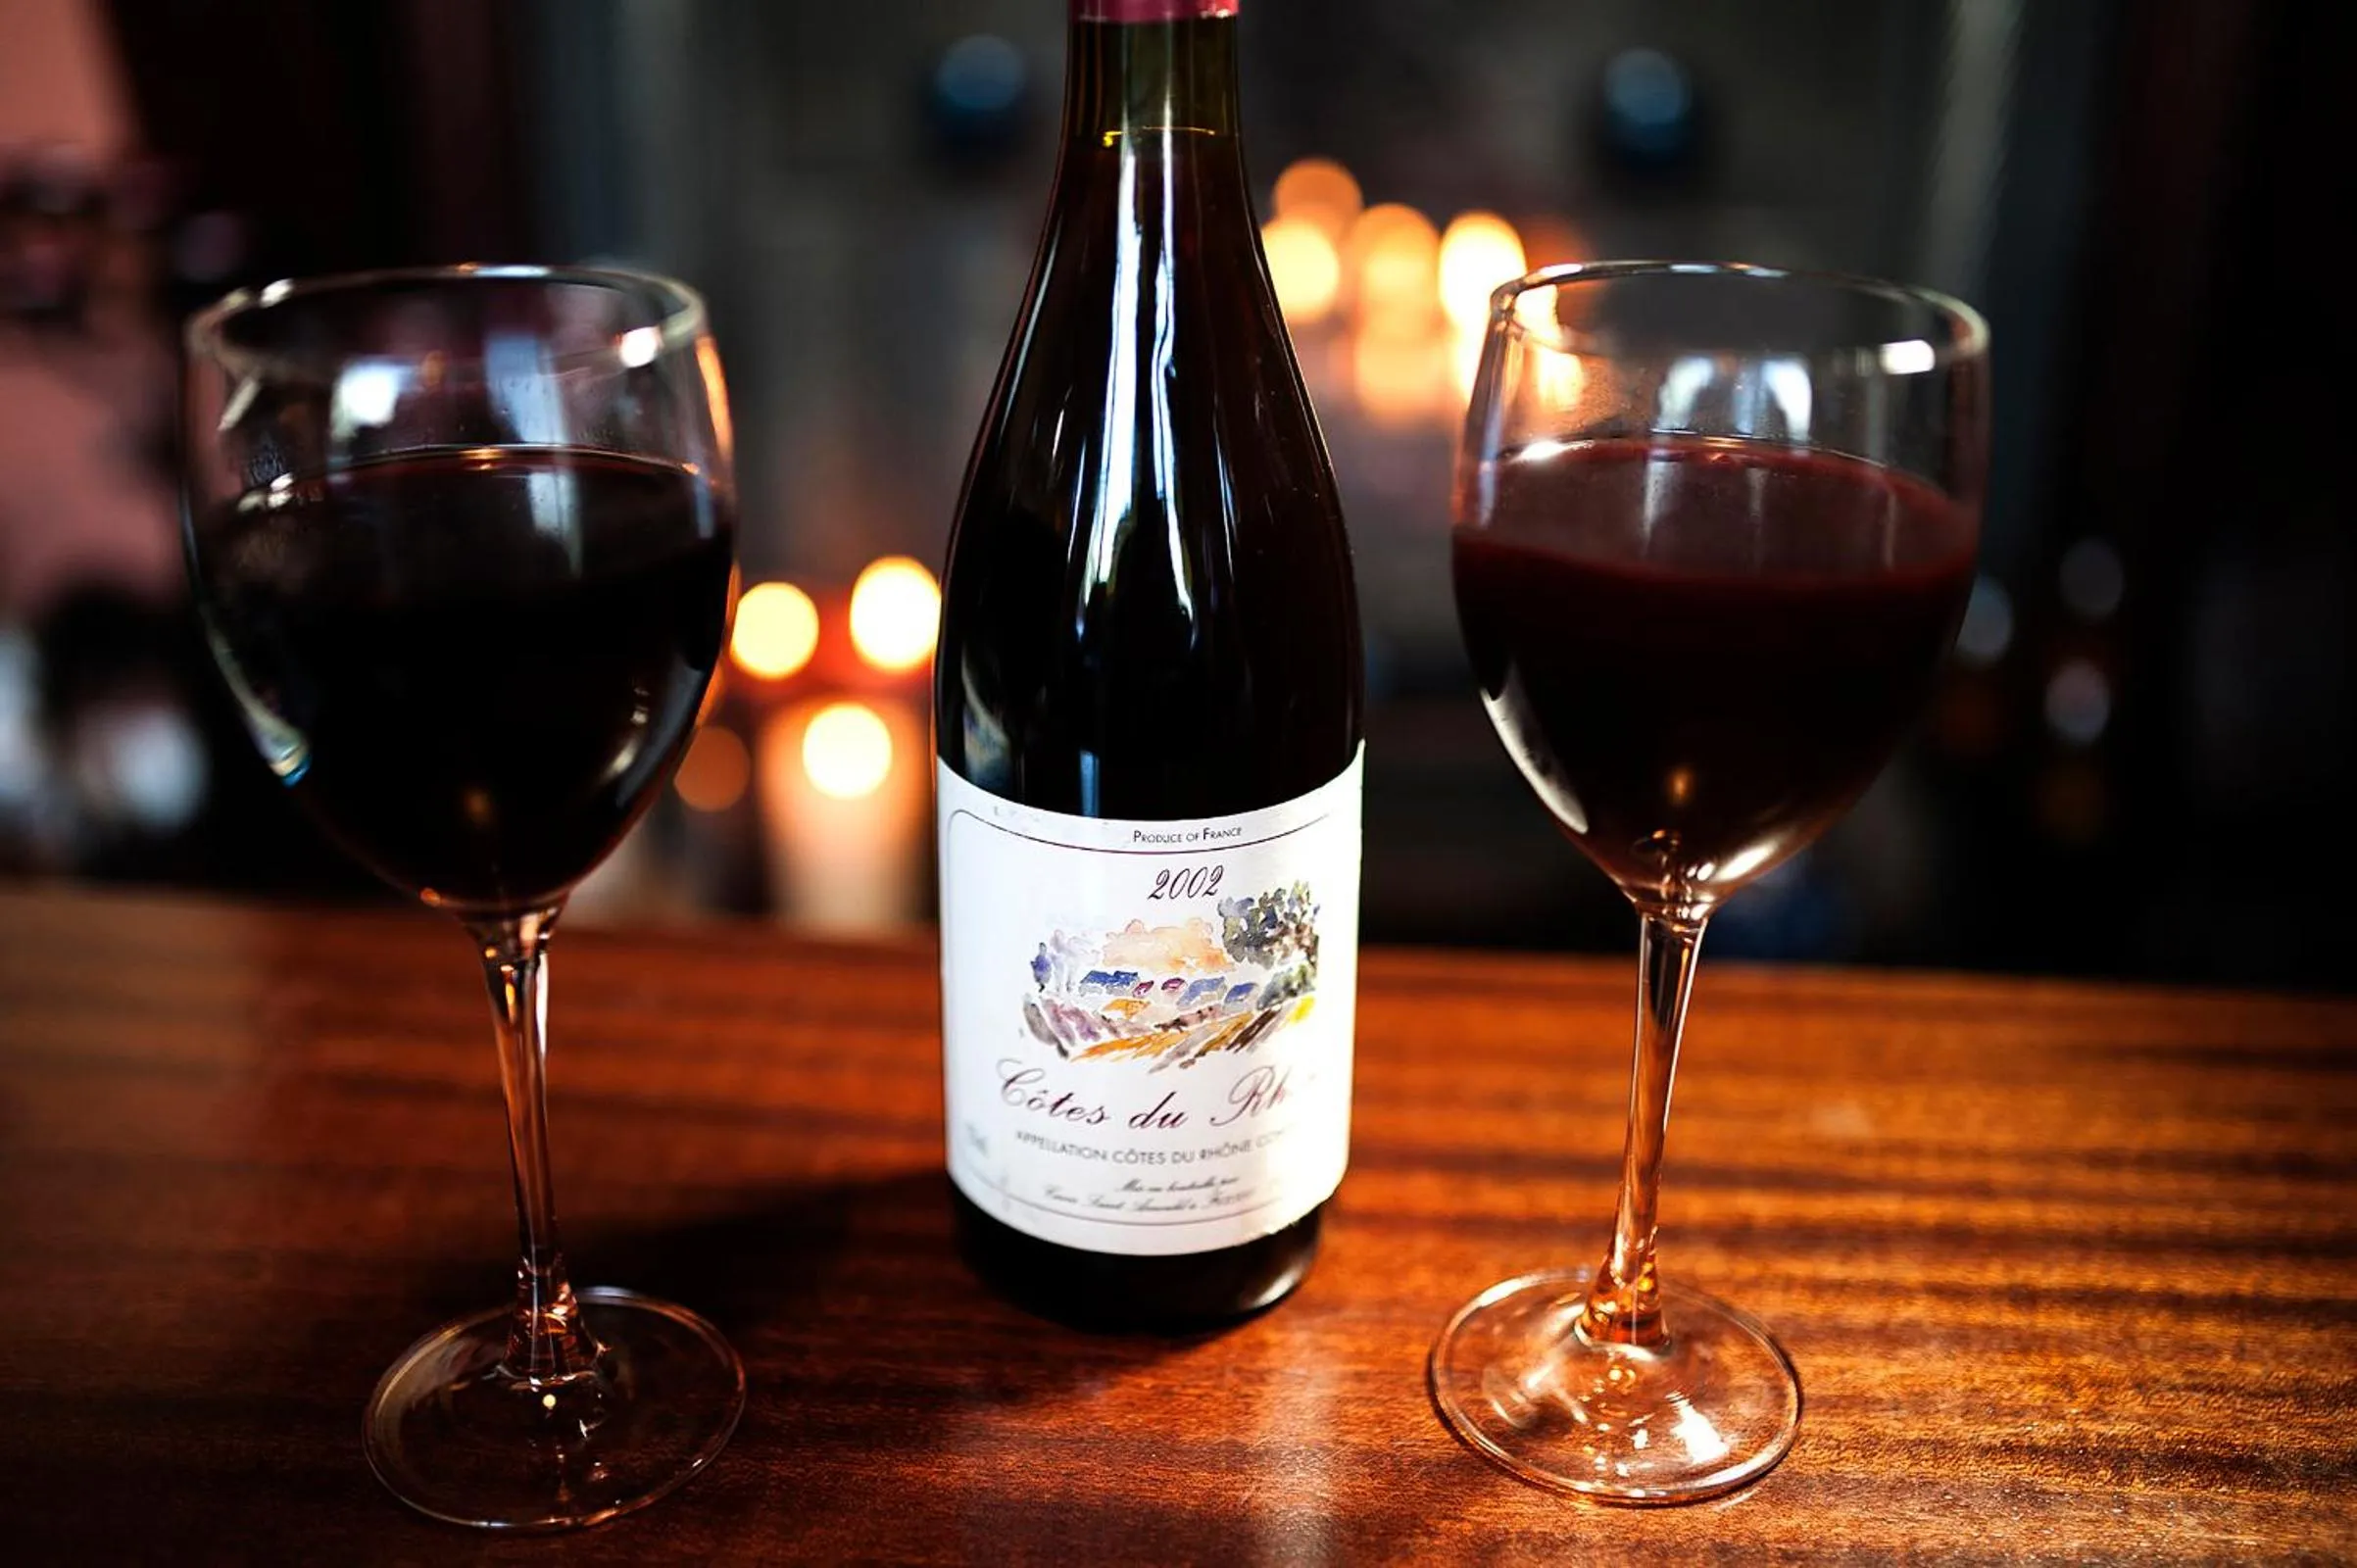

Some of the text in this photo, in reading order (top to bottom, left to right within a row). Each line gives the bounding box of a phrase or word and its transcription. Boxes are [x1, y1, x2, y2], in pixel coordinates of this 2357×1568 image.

[1133, 830, 1182, 844] PRODUCE
[1203, 826, 1242, 840] FRANCE
[1147, 864, 1224, 900] 2002
[996, 1058, 1111, 1125] Côtes
[1128, 1091, 1189, 1129] du
[1016, 1130, 1107, 1161] APPELLATION
[1111, 1148, 1166, 1165] CÔTES
[1171, 1151, 1194, 1164] DU
